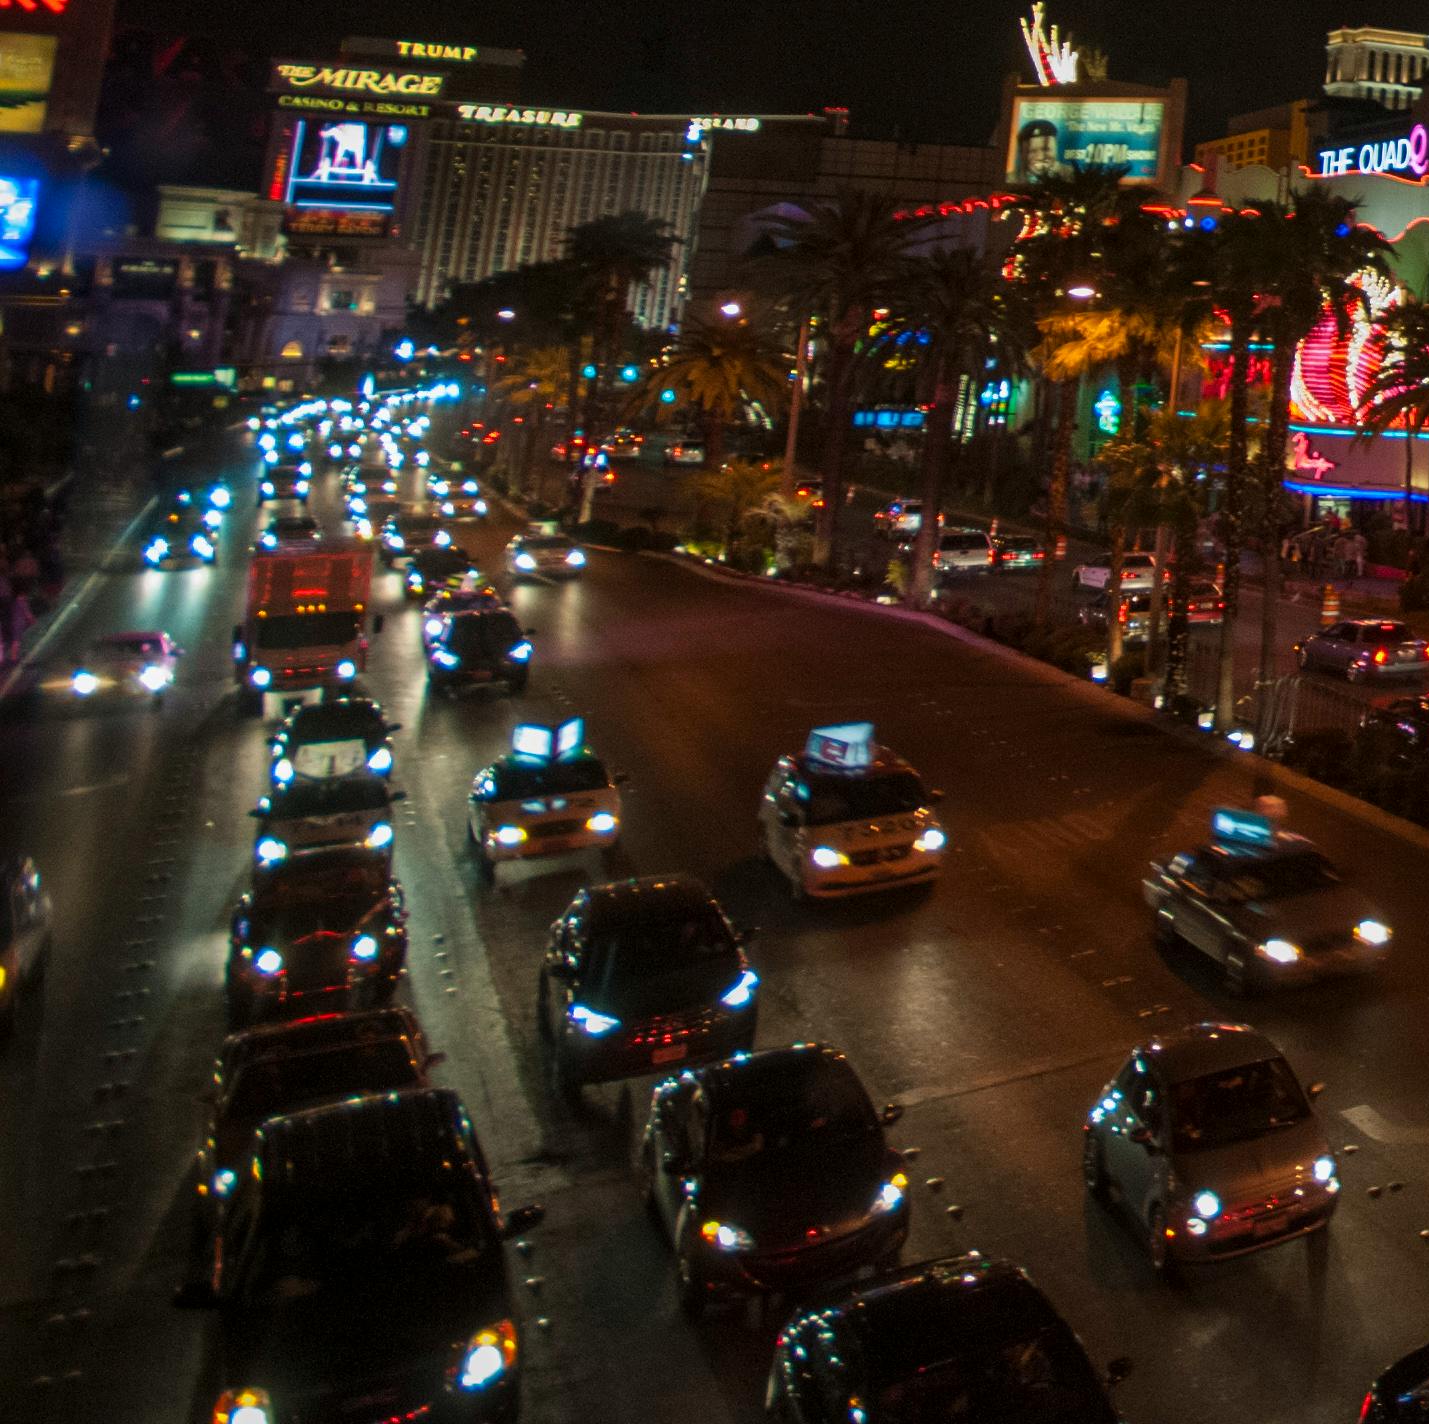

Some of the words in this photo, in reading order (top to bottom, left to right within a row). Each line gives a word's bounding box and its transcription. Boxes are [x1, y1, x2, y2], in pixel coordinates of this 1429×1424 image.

[396, 41, 477, 61] TRUMP
[278, 65, 317, 78] THE
[303, 67, 443, 95] MIRAGE
[278, 95, 343, 112] CASINO
[363, 102, 430, 118] RESORT
[458, 105, 583, 127] TREASURE
[1021, 104, 1089, 119] GEORGE
[1320, 148, 1354, 176] THE
[1359, 138, 1410, 173] QUAD
